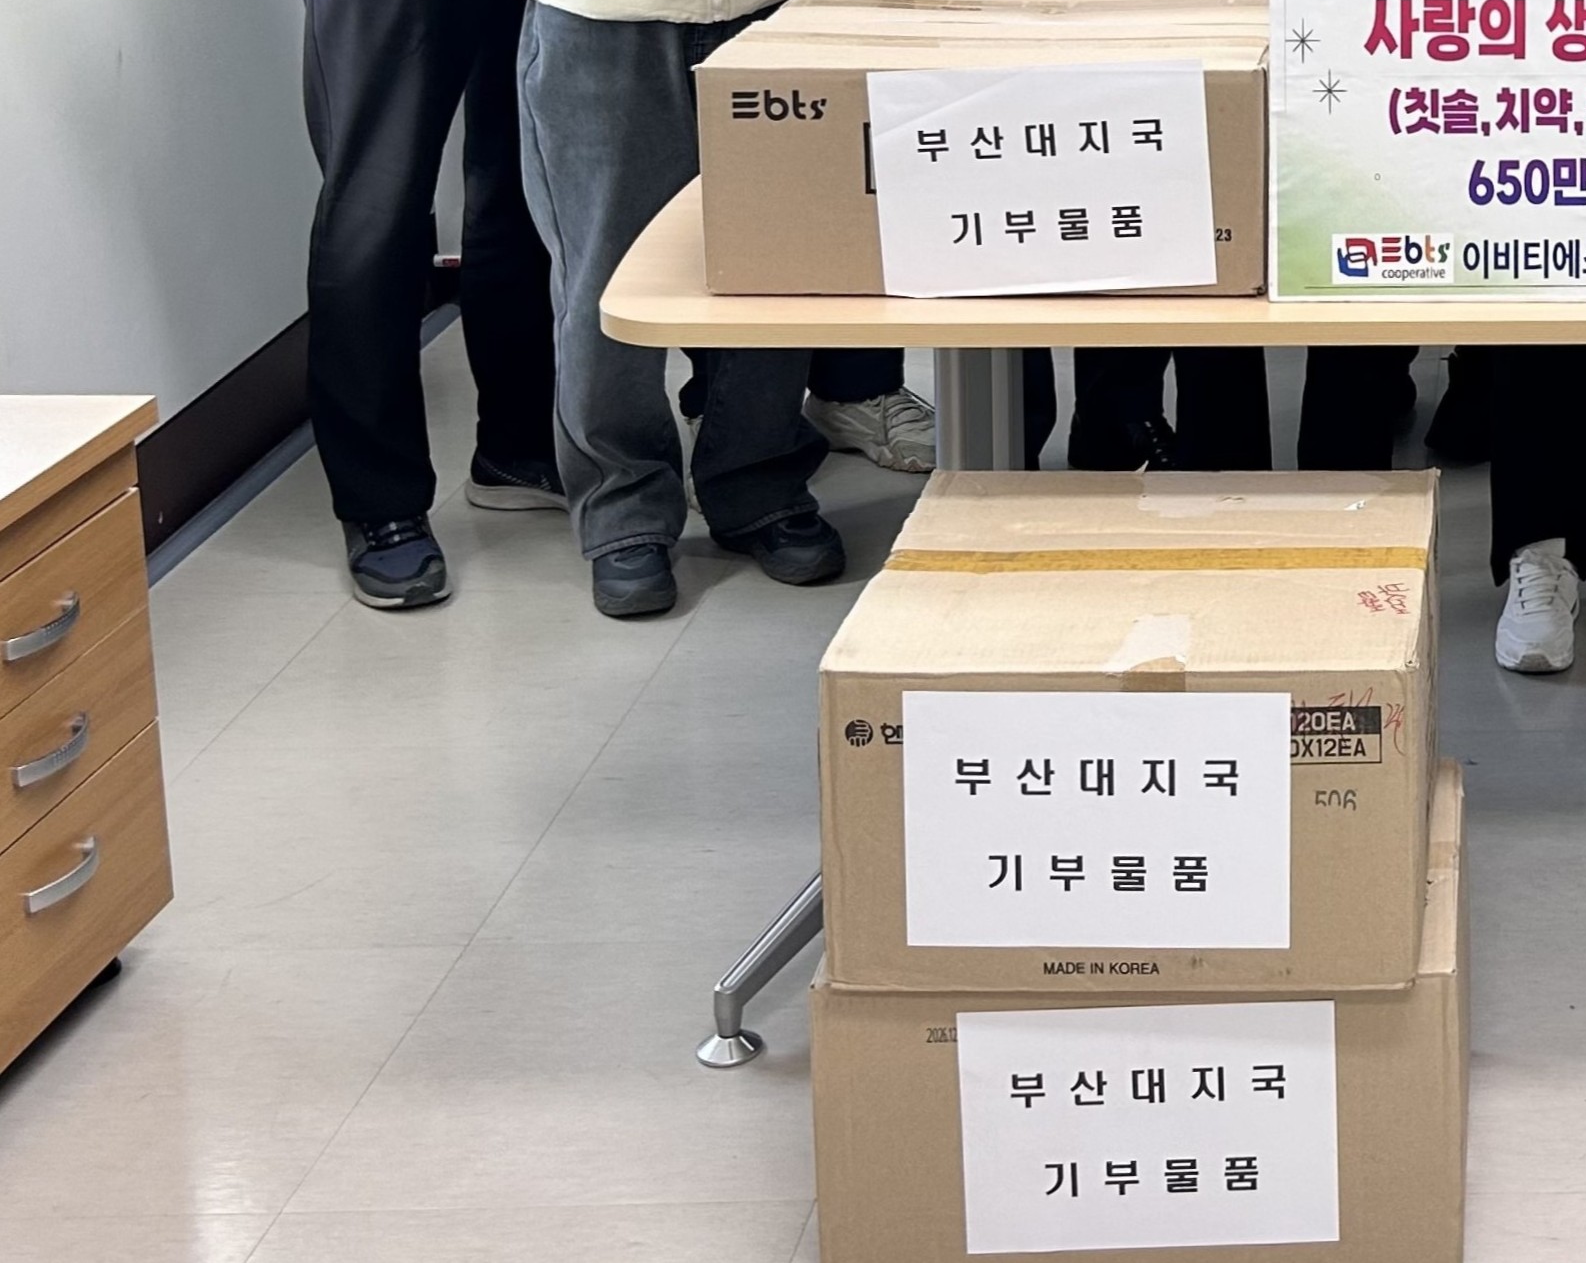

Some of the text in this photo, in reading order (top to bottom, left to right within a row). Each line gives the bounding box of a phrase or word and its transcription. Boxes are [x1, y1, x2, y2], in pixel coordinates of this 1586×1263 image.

[1381, 268, 1446, 281] cooperative
[1043, 962, 1160, 975] MADE IN KOREA
